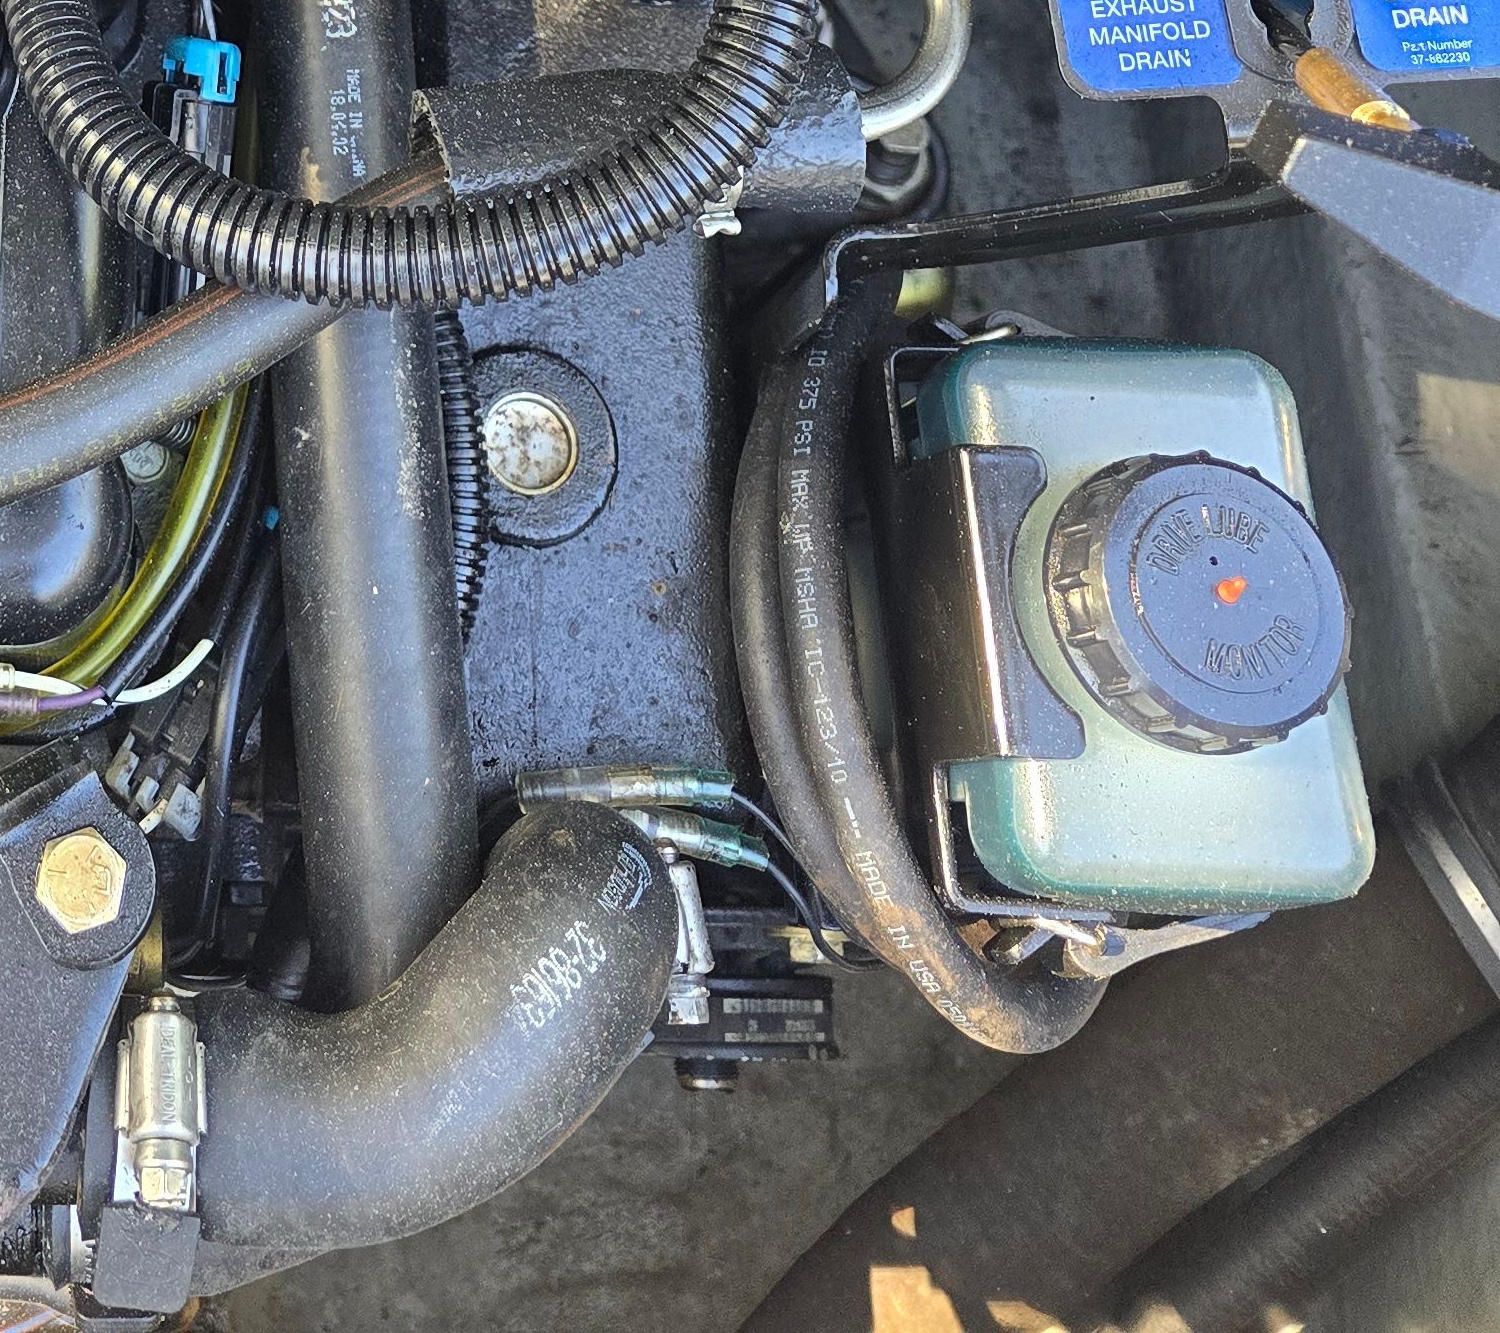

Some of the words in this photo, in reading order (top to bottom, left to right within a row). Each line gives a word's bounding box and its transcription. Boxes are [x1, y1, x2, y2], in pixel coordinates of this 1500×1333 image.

[1088, 19, 1211, 47] MANIFOLD
[1391, 4, 1470, 29] DRAIN
[1118, 48, 1192, 73] DRAIN
[1427, 38, 1473, 51] Number
[799, 377, 821, 410] 375
[793, 418, 812, 456] PSI
[1146, 509, 1205, 576] DRIVE
[1201, 504, 1269, 554] LUBE
[797, 568, 818, 630] MSHA
[1204, 614, 1307, 680] MONITOR
[856, 851, 894, 912] MADE
[888, 925, 915, 950] IN
[909, 959, 941, 993] USA
